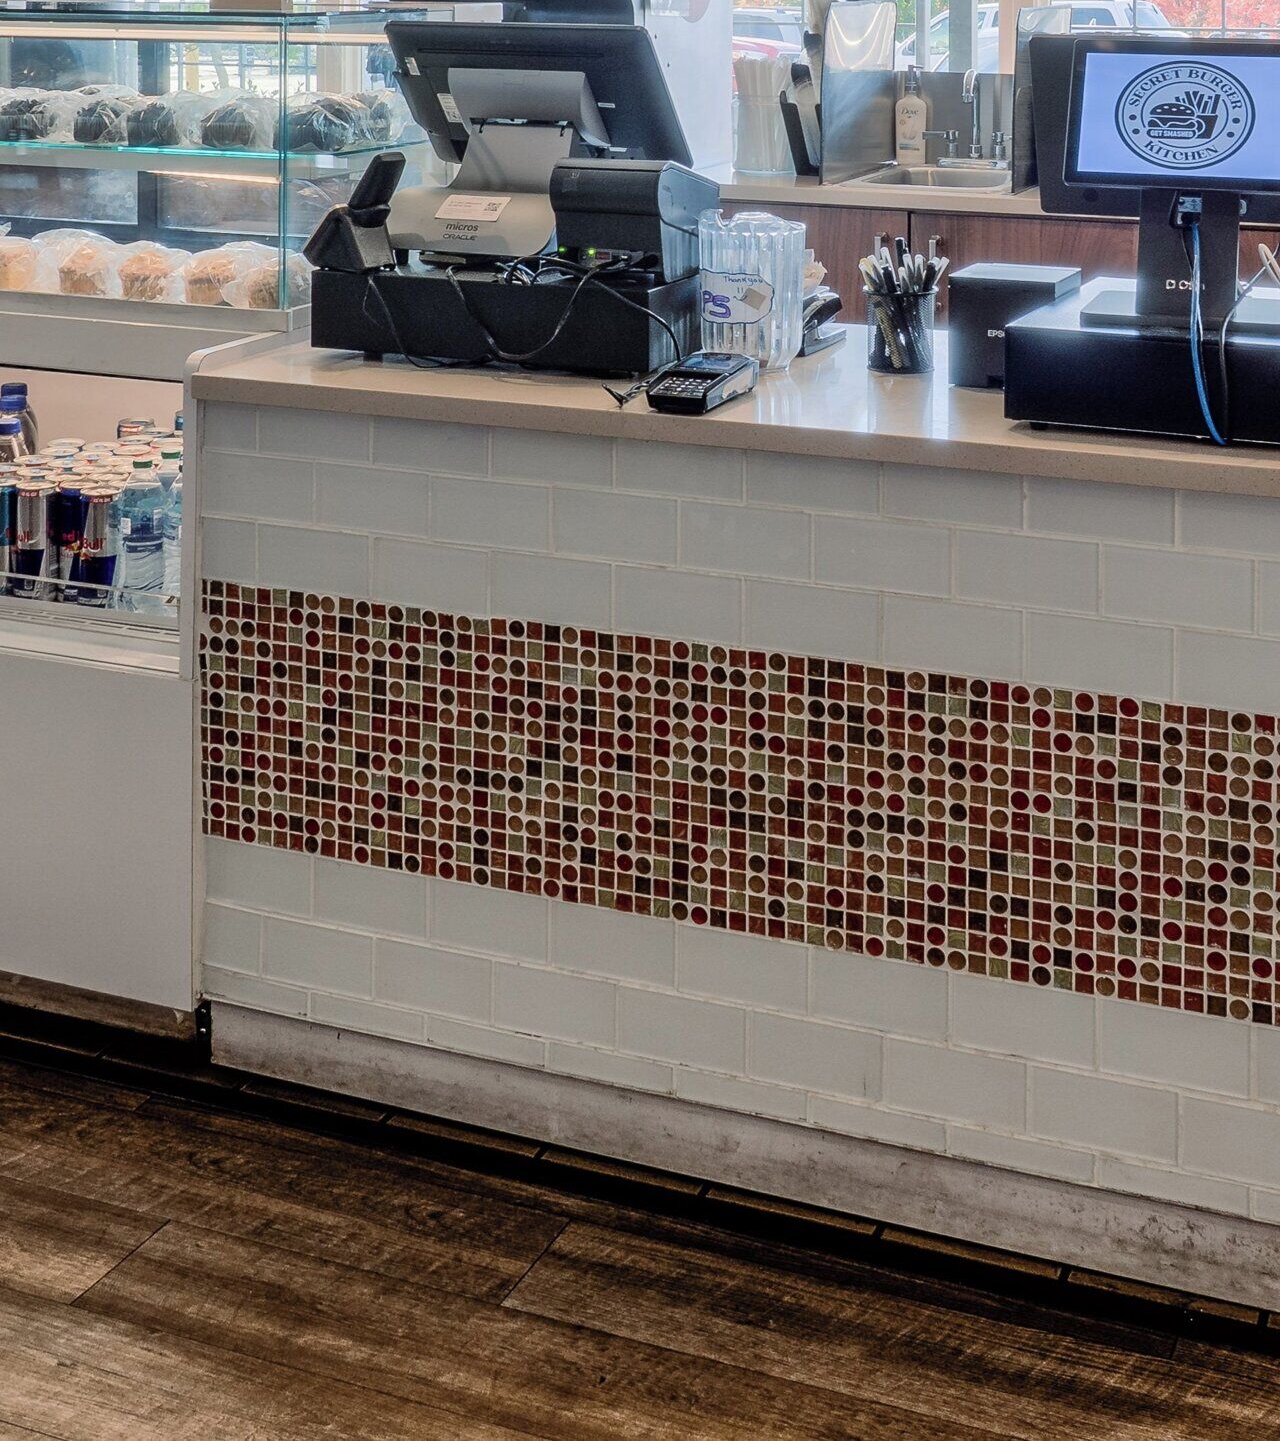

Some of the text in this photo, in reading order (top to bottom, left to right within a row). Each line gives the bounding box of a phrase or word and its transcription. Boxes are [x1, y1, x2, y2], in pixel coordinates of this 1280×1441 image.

[1128, 69, 1243, 110] SECRET BURGER
[1144, 140, 1218, 161] KITCHEN
[445, 221, 479, 232] micros
[442, 233, 477, 241] ORACLE
[724, 275, 763, 286] Thank you
[702, 290, 732, 318] PS
[987, 329, 1005, 338] EPS
